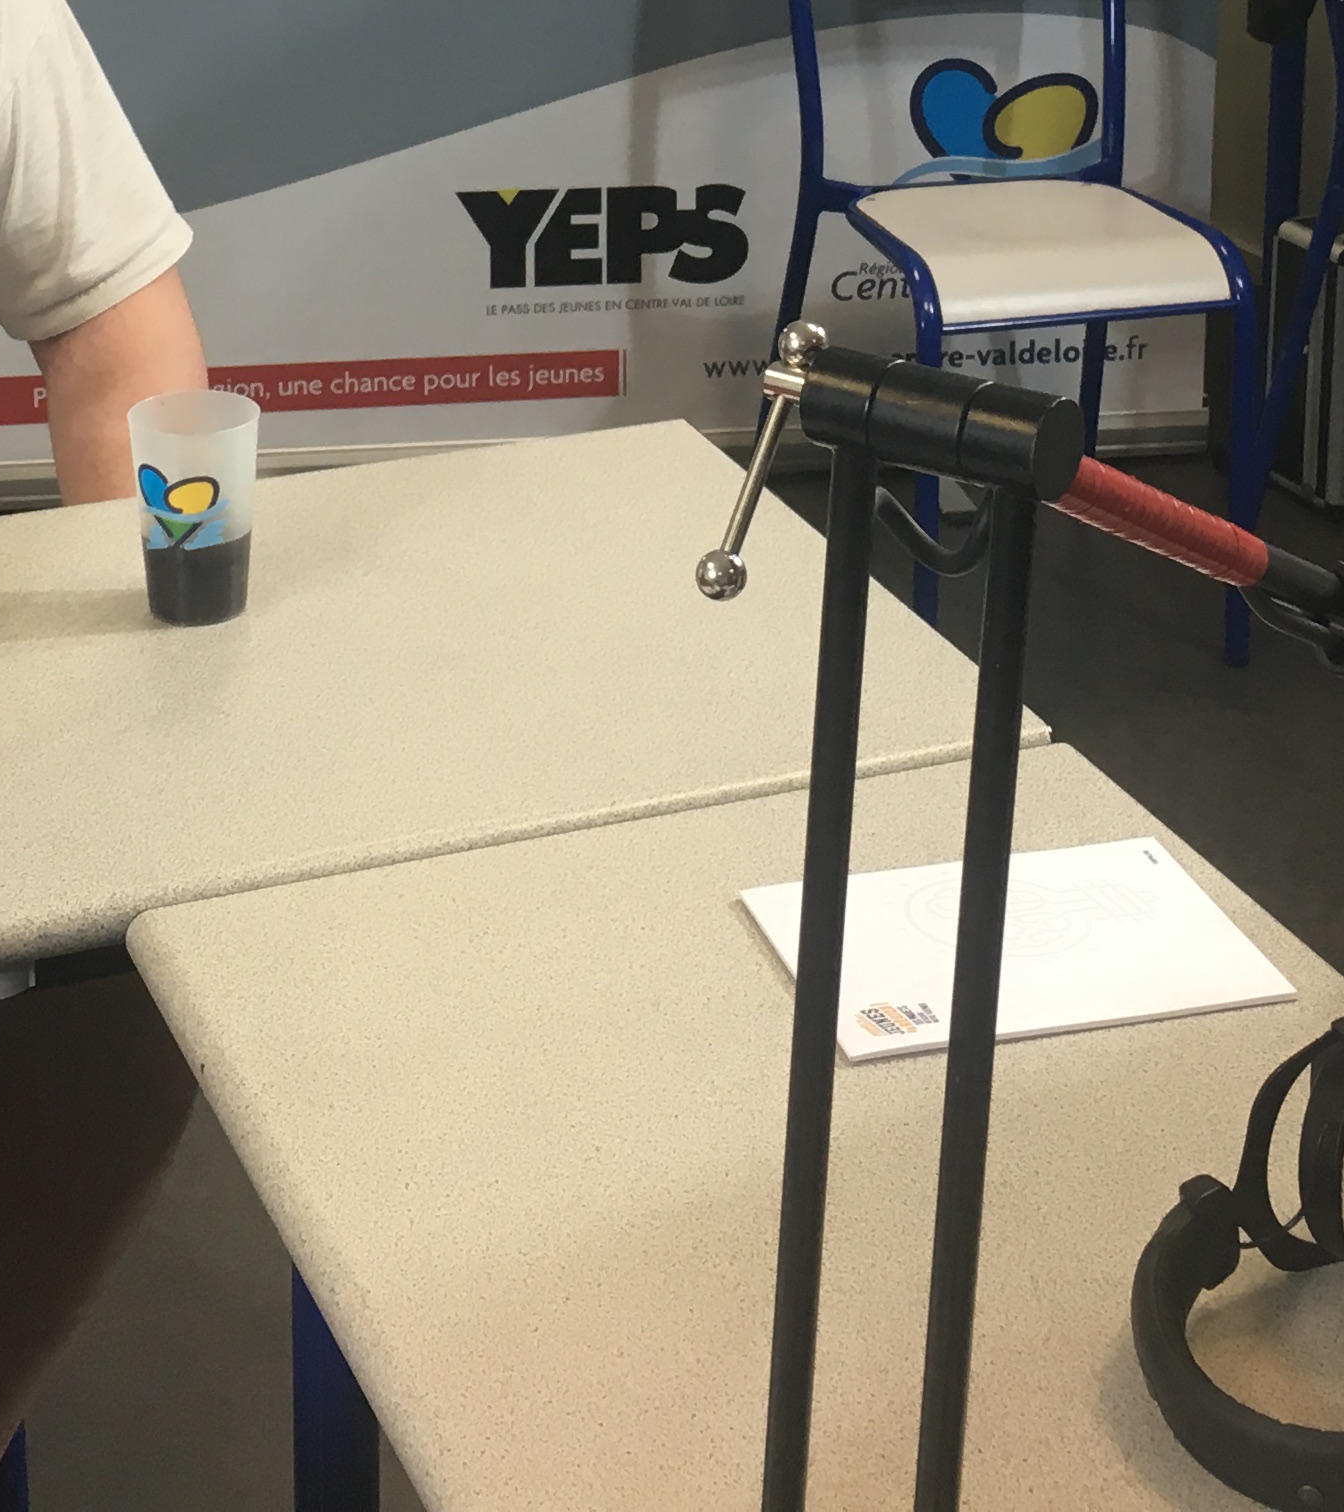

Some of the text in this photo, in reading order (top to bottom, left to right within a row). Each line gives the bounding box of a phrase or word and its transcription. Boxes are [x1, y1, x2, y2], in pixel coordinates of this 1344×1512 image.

[455, 182, 749, 291] YEPS
[859, 262, 903, 279] Régio
[486, 295, 745, 316] LE PASS DES JEUNES EN CENTRE VAL DE LOIRE
[278, 376, 323, 397] une
[329, 364, 415, 394] chance
[423, 364, 477, 397] pour
[487, 363, 522, 389] les
[527, 359, 606, 393] jeunes
